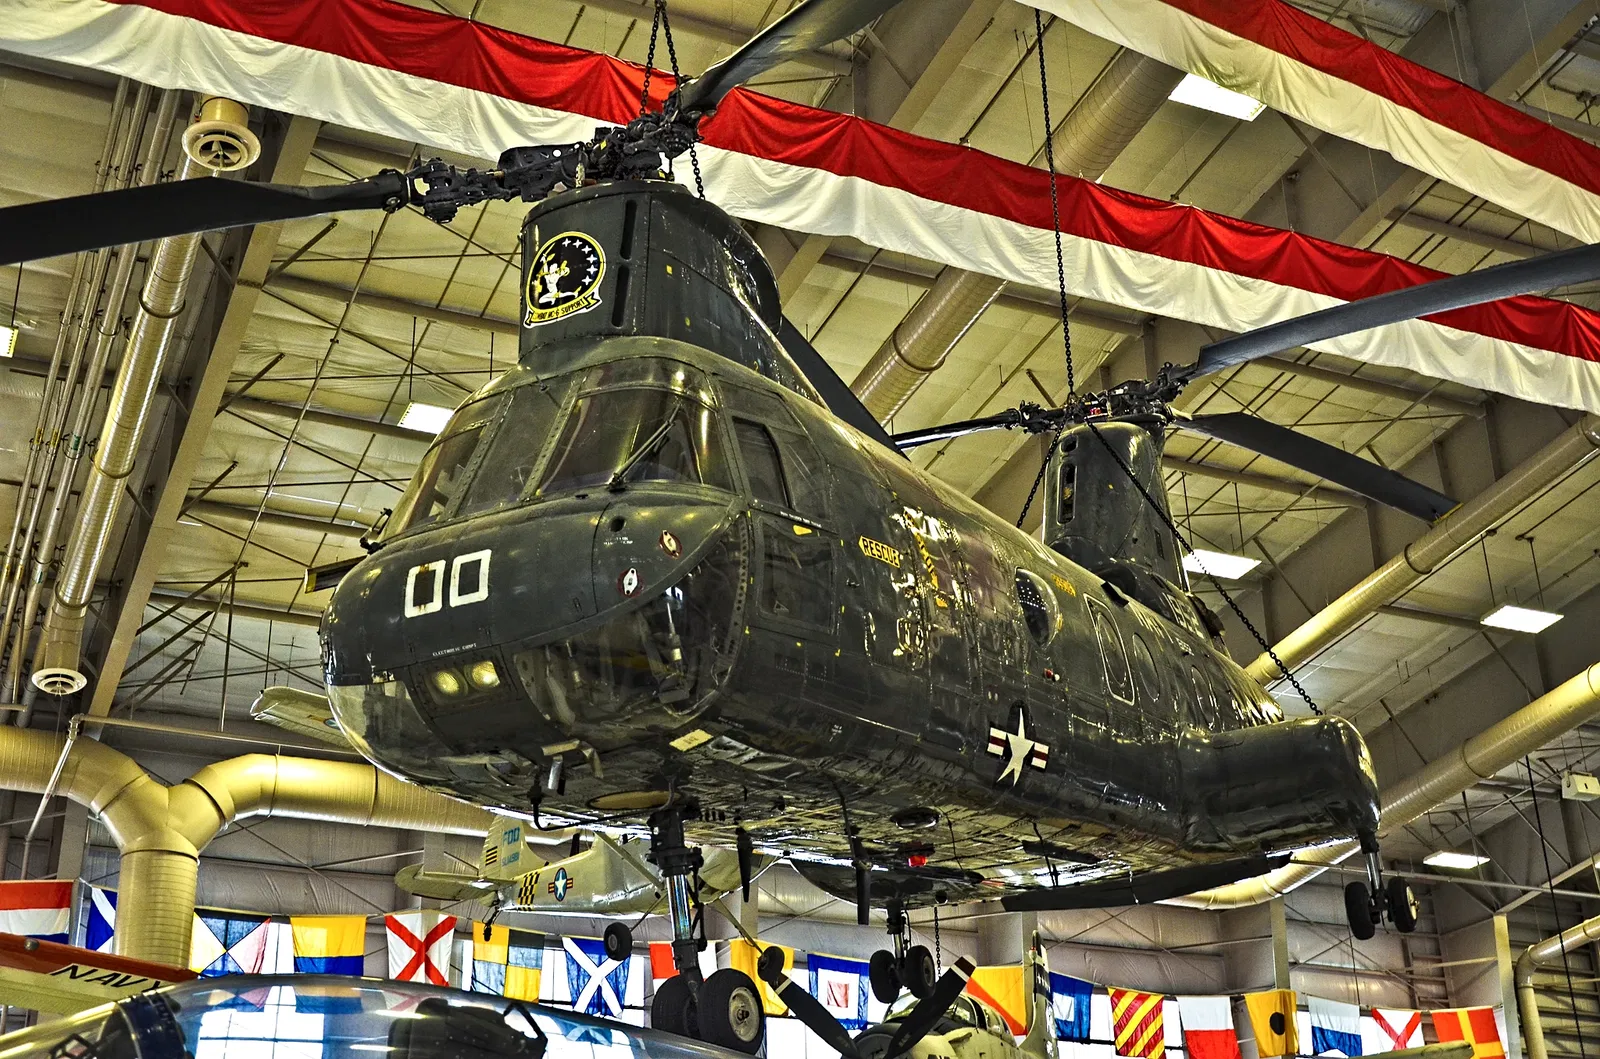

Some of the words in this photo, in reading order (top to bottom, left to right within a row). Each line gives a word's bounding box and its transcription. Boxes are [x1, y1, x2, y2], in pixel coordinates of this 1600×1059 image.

[561, 299, 585, 314] SUPPORT
[862, 538, 899, 567] RESCUE
[404, 549, 492, 618] 00
[49, 964, 171, 993] NAVY
